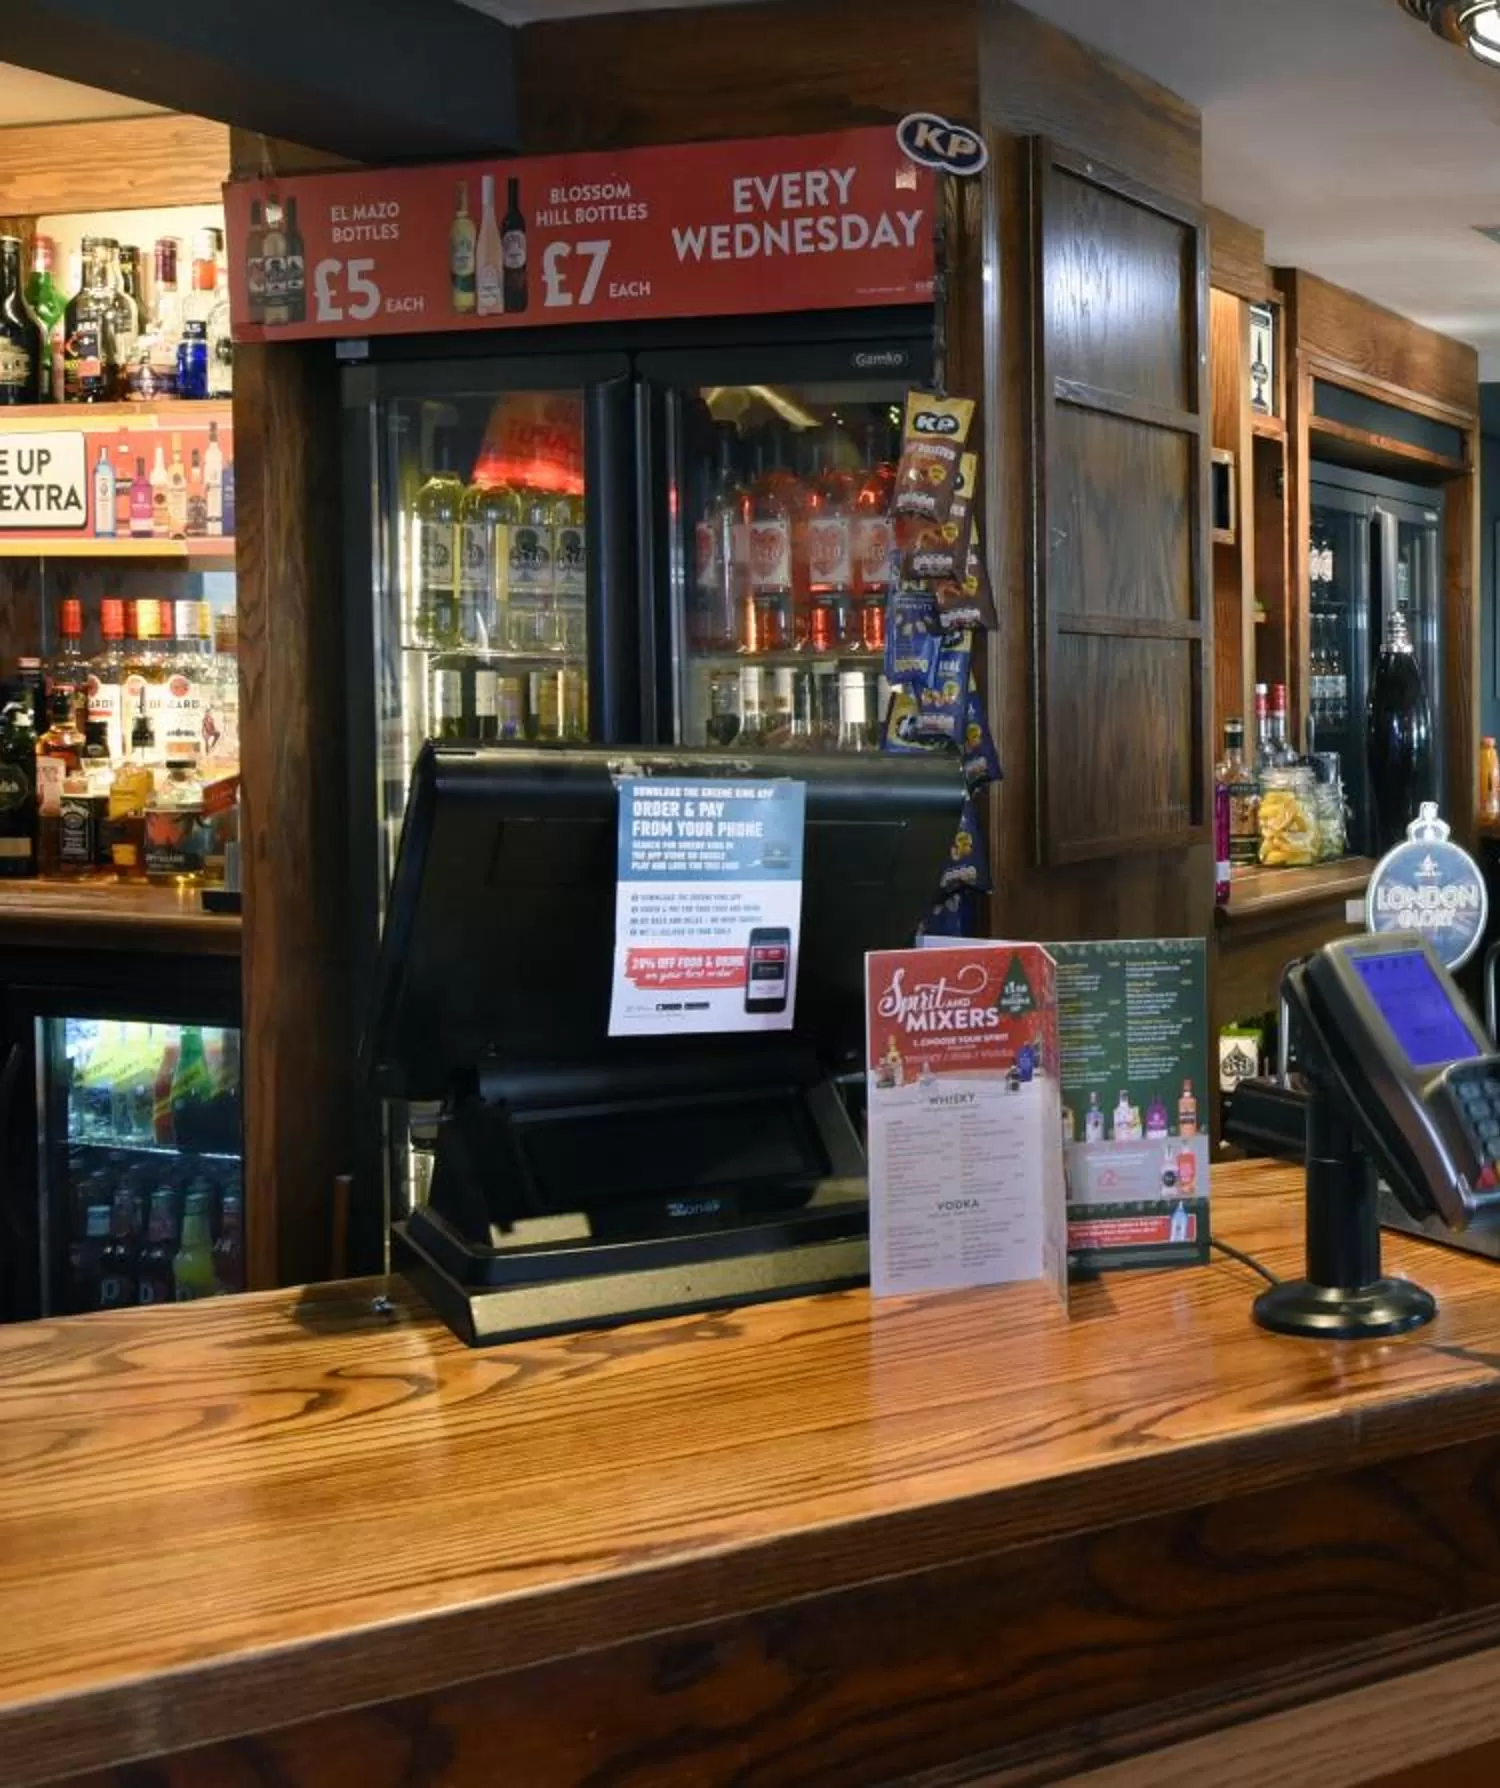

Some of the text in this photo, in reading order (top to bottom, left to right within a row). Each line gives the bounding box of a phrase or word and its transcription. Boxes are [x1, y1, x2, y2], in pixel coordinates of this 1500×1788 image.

[914, 121, 977, 158] KP
[550, 184, 631, 204] BLOSSOM
[733, 167, 856, 213] EVERY
[331, 202, 400, 222] EL MAZO
[536, 203, 649, 227] HILL BOTTLES
[332, 225, 399, 242] BOTTLES
[672, 209, 923, 263] WEDNESDAY
[543, 240, 611, 307] £7
[313, 257, 381, 321] £5
[609, 281, 651, 298] EACH
[385, 296, 424, 314] EACH
[915, 414, 956, 431] KP
[17, 449, 51, 476] UP
[0, 484, 83, 511] EXTRA
[632, 801, 725, 817] ORDER & PAY
[632, 821, 764, 837] FROM YOUR PHONE
[1377, 884, 1479, 911] LONDON
[1398, 908, 1457, 928] GLORY
[878, 964, 988, 1023] Spirit
[906, 1007, 1000, 1033] MIXERS
[937, 1199, 980, 1211] VODKA
